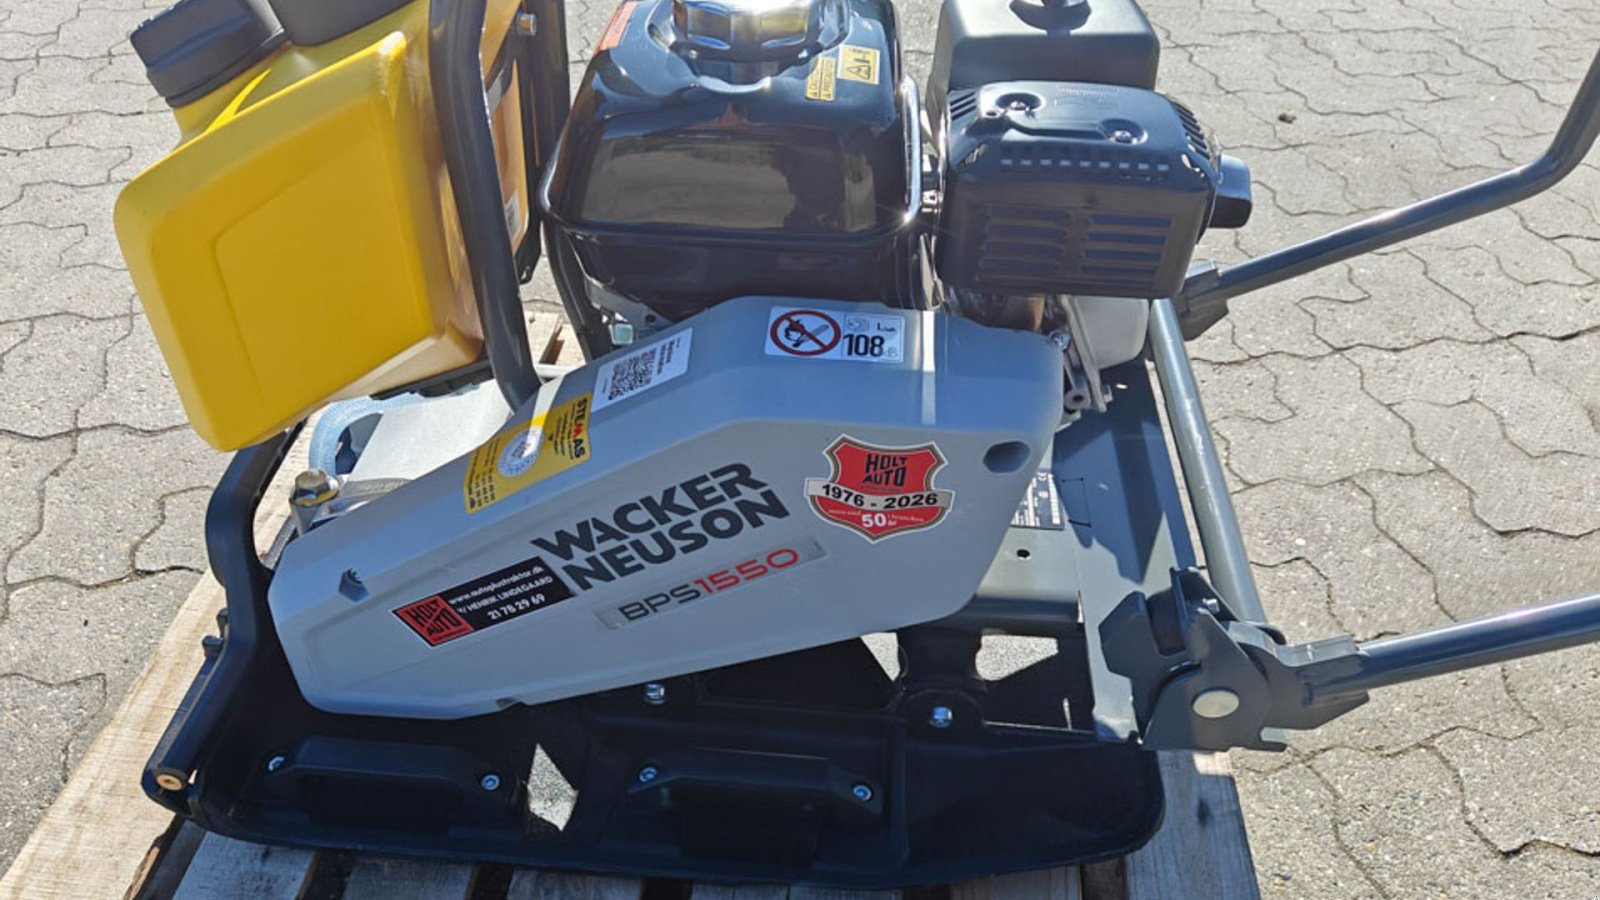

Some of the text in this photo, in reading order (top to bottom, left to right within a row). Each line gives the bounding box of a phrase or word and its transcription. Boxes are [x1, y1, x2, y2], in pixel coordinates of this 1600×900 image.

[843, 334, 885, 357] 108
[863, 466, 908, 487] AUTO
[866, 453, 908, 474] HOLT
[822, 484, 865, 507] 1976
[884, 493, 938, 509] 2026
[530, 463, 768, 560] WACKER
[861, 512, 887, 528] 50
[562, 489, 790, 591] NEUSON
[496, 576, 553, 600] LINDEGAARD
[618, 548, 798, 621] BPS1550
[406, 599, 443, 628] HOLT
[487, 593, 546, 620] 21 78 29 69
[427, 606, 461, 637] AUTO
